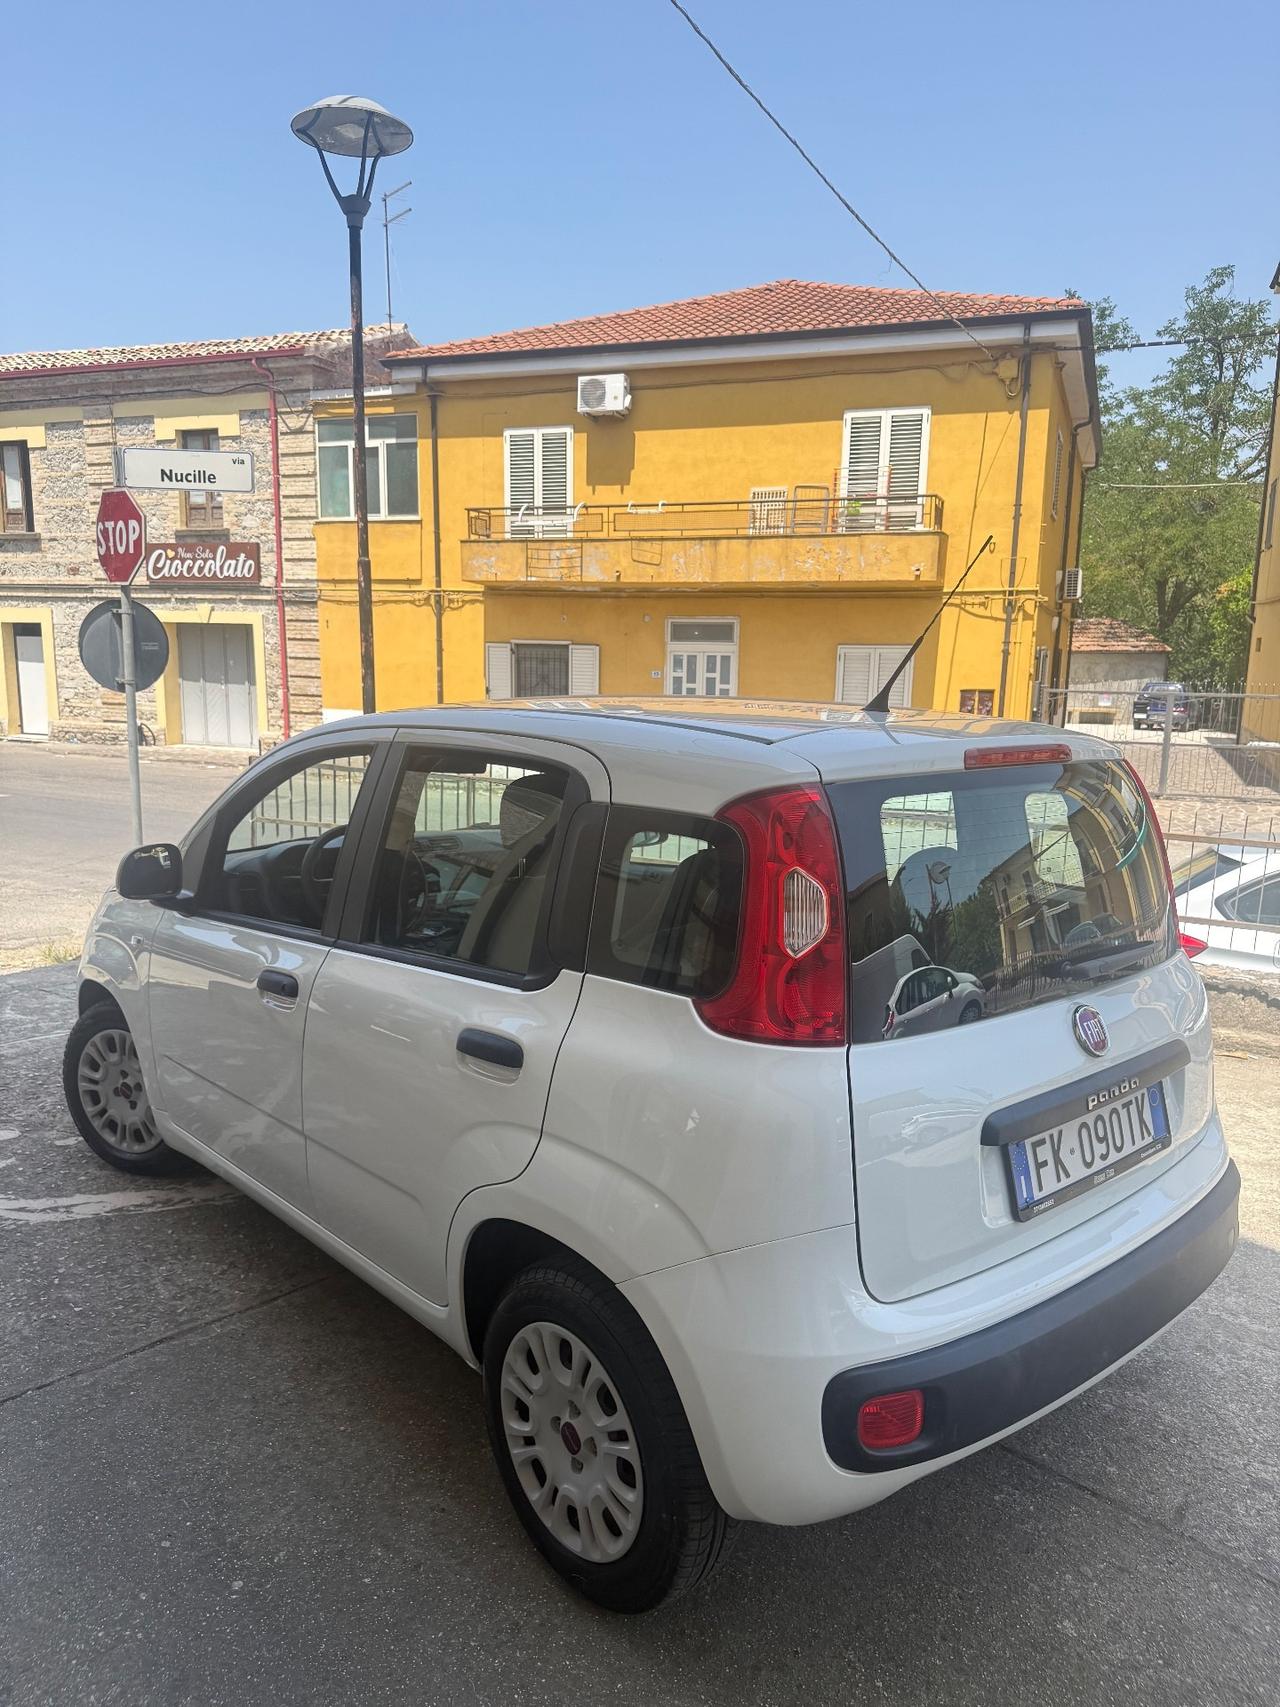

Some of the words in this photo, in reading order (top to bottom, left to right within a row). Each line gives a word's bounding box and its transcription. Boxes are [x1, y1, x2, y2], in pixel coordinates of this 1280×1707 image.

[231, 457, 246, 465] via
[160, 468, 217, 484] Nucille
[97, 519, 141, 556] STOP
[147, 545, 255, 580] Cioccolato
[1083, 1018, 1106, 1043] FIAT
